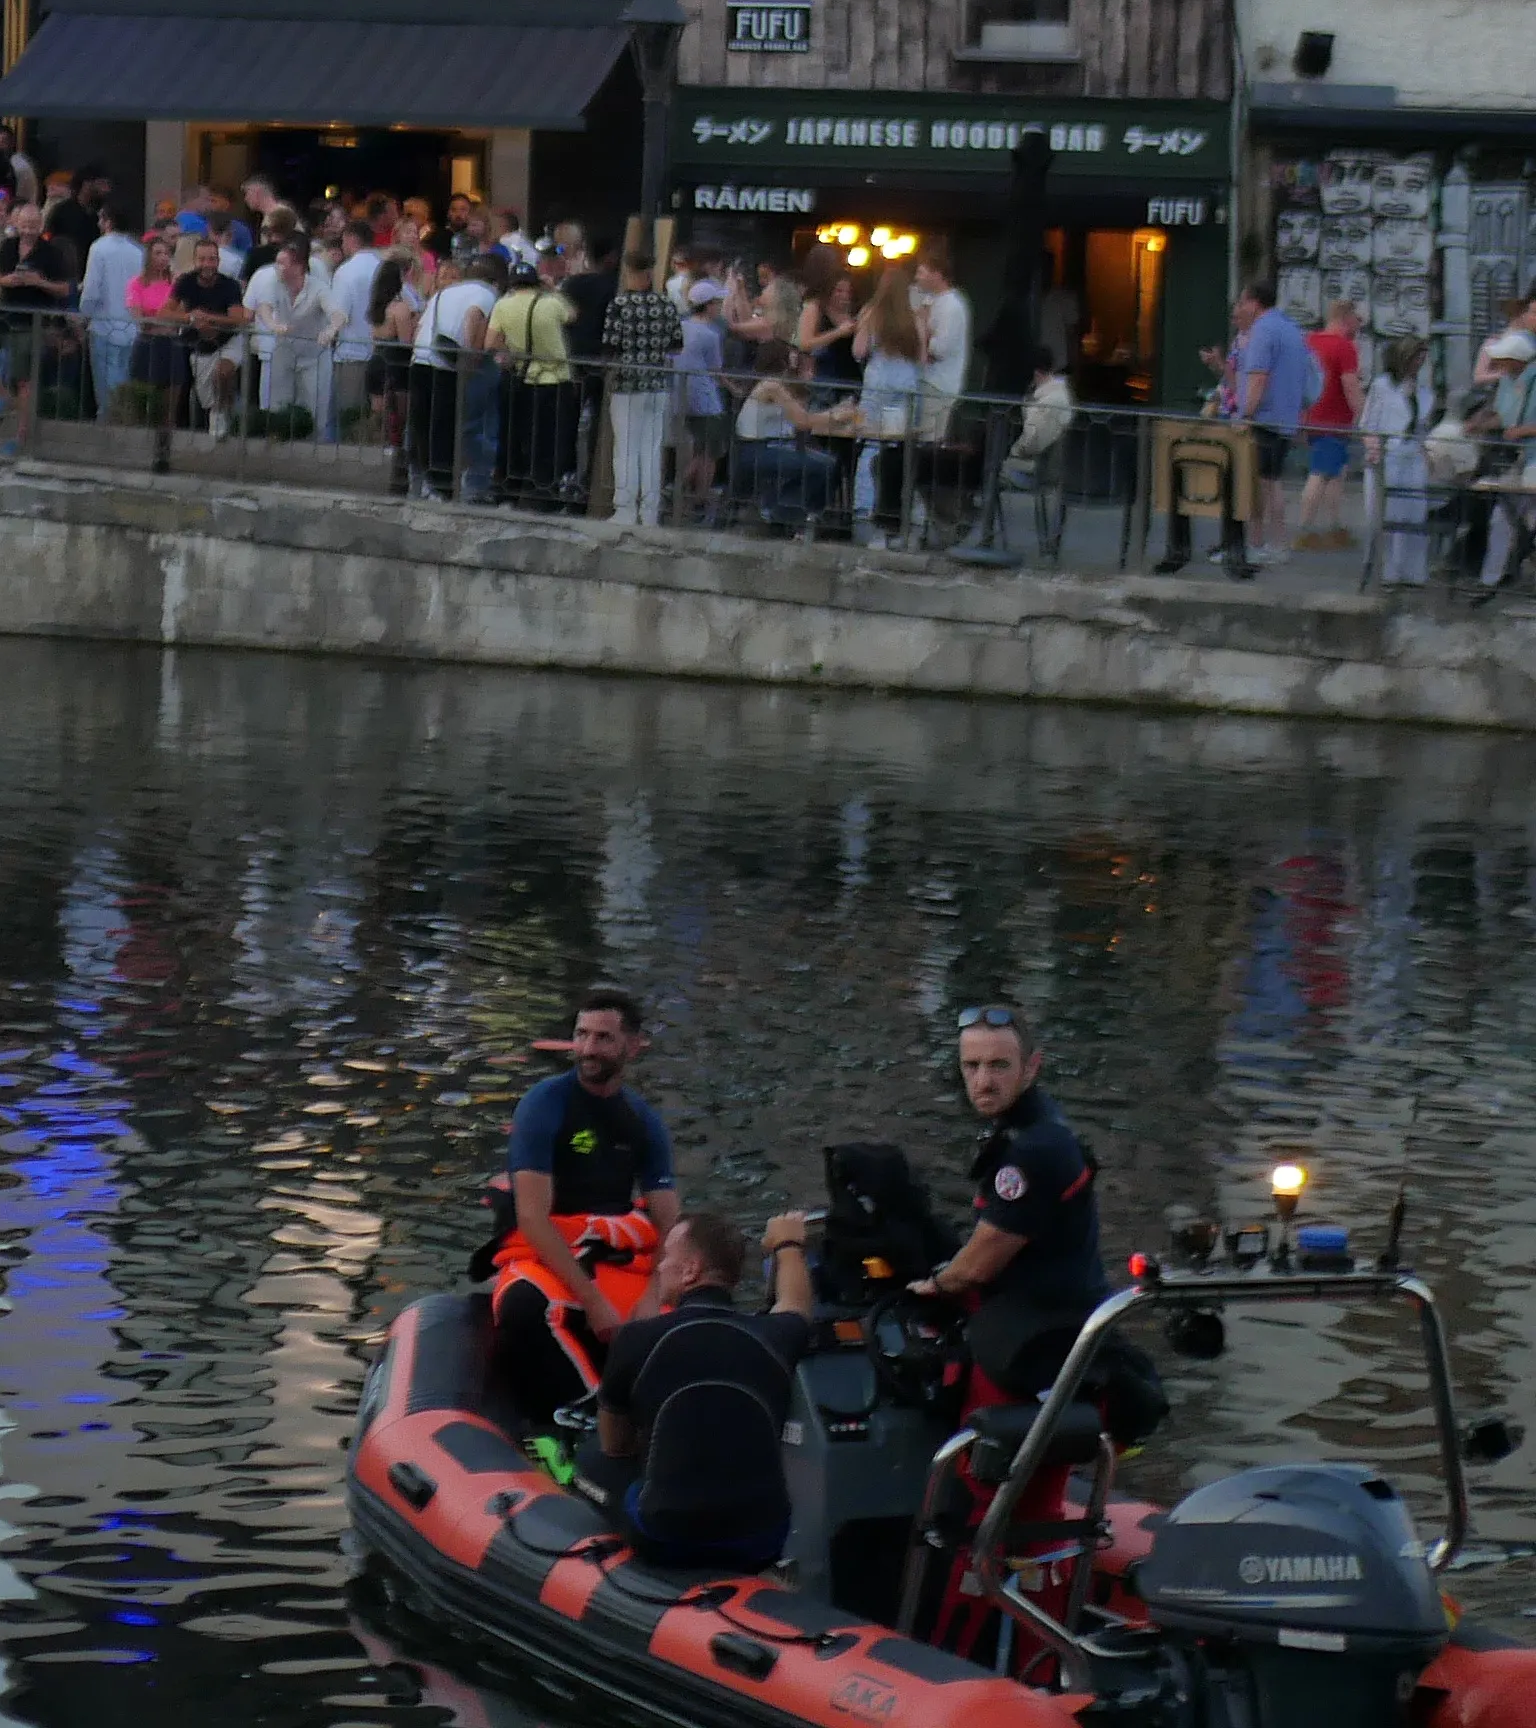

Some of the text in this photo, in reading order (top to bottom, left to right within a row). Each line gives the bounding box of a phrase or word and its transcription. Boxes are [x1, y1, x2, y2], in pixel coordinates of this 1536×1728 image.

[736, 9, 801, 40] FUFU
[785, 119, 920, 147] JAPANESE
[1049, 124, 1106, 151] BAR
[1147, 198, 1205, 225] FUFU
[1265, 1555, 1362, 1582] YAMAHA
